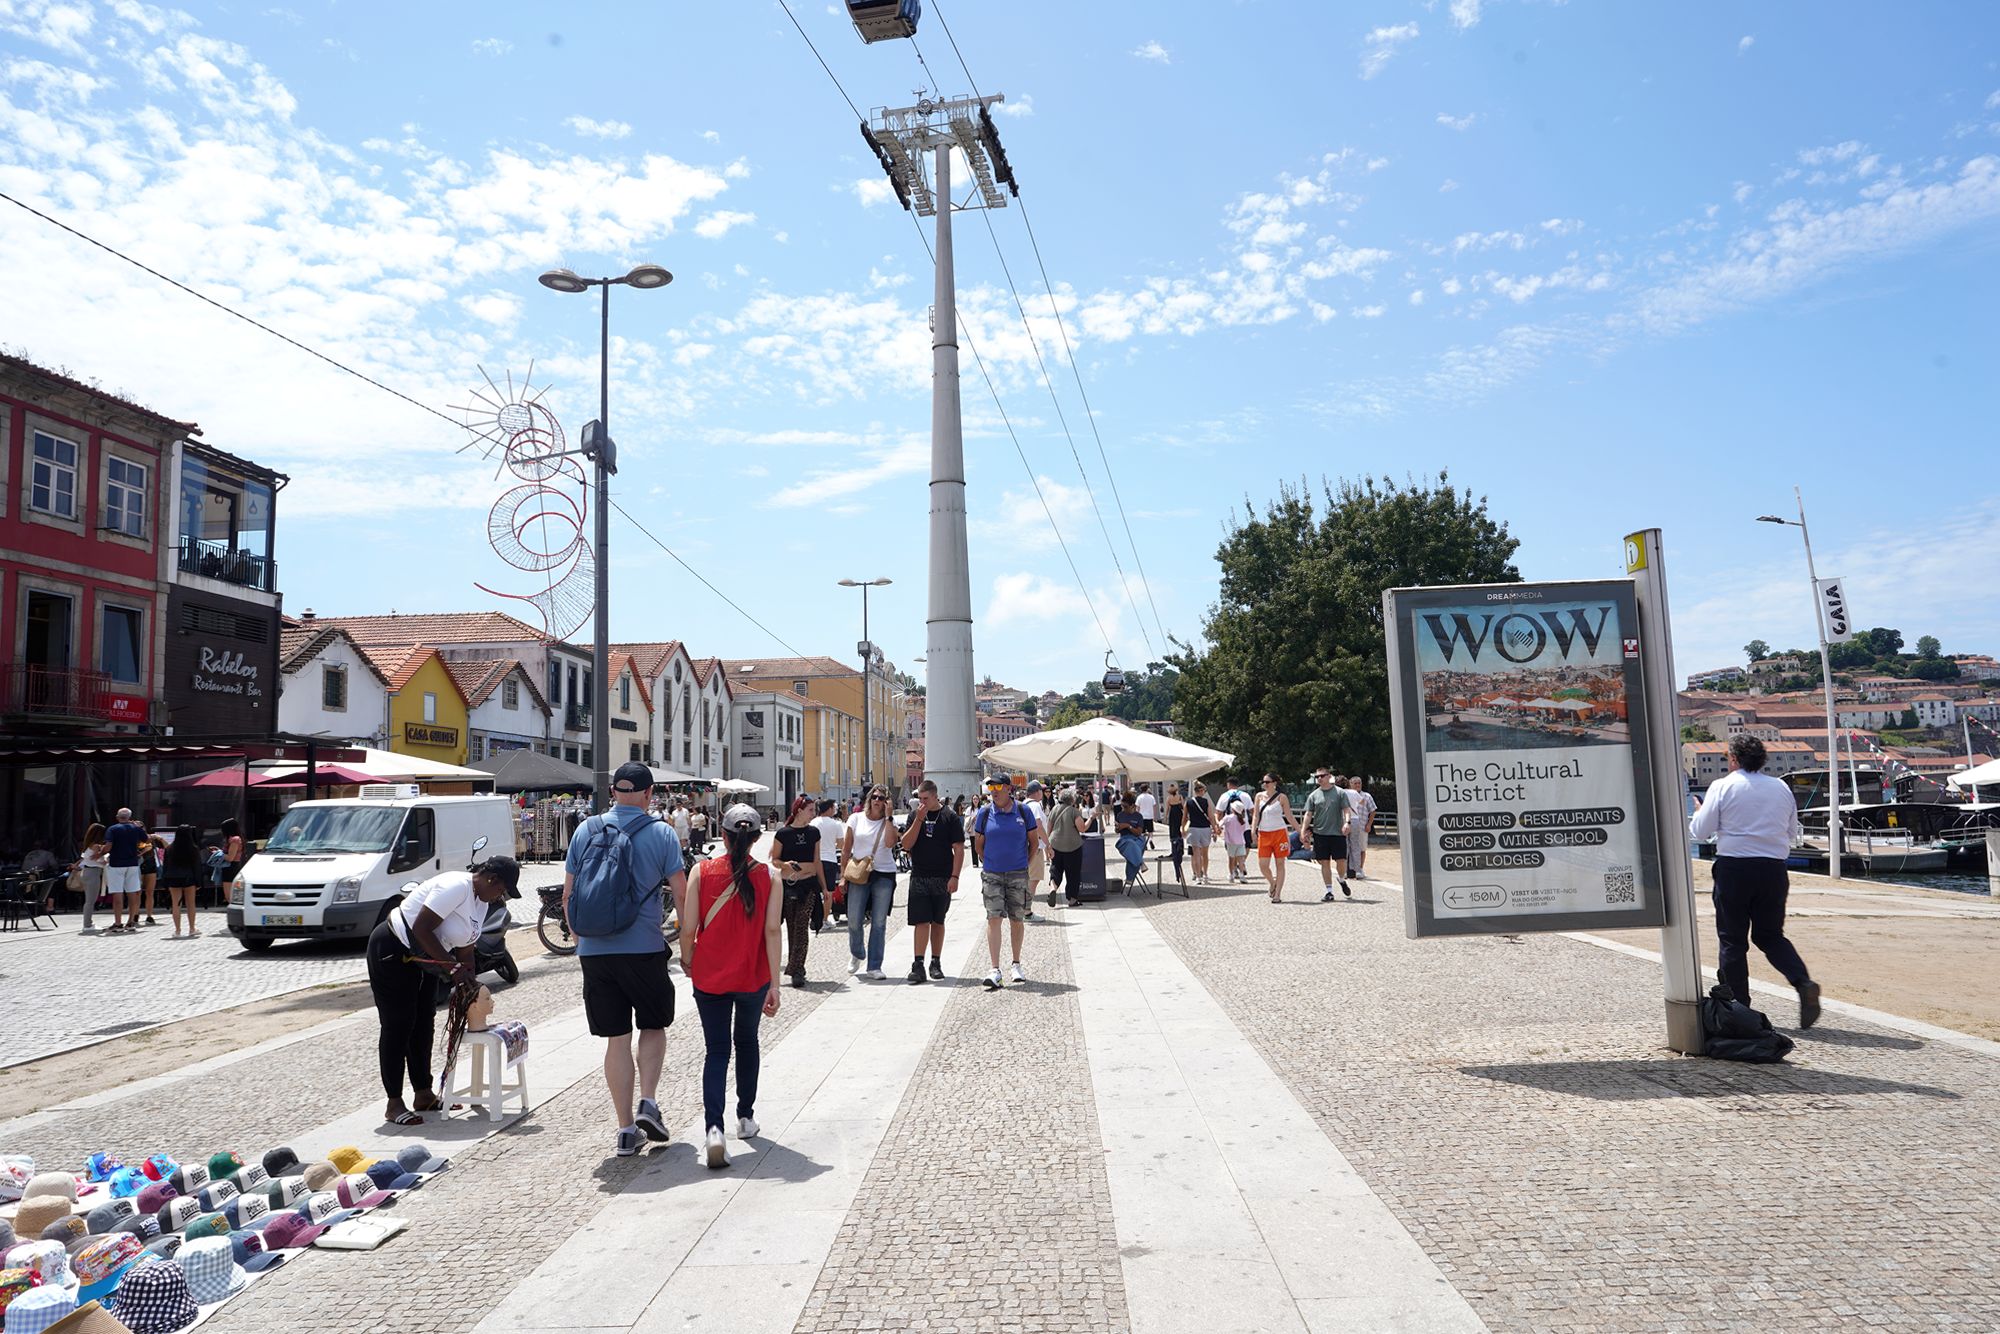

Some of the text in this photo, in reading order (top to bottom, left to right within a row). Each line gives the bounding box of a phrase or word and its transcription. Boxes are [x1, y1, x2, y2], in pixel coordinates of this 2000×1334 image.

[1486, 592, 1543, 600] DREAMMEDIA
[1825, 584, 1847, 635] GAIA
[1422, 606, 1612, 664] WOW
[200, 646, 258, 679] Rabelos
[194, 674, 262, 696] Restaurante Bar
[408, 727, 428, 741] CASA
[1434, 759, 1583, 782] The Cultural
[1435, 783, 1526, 803] District
[1443, 809, 1621, 828] MUSEUMS RESTAURANTS
[1444, 830, 1603, 849] SHOPS WINE SCHOOL
[1445, 853, 1540, 868] PORT LODGES
[1469, 891, 1500, 902] 150M
